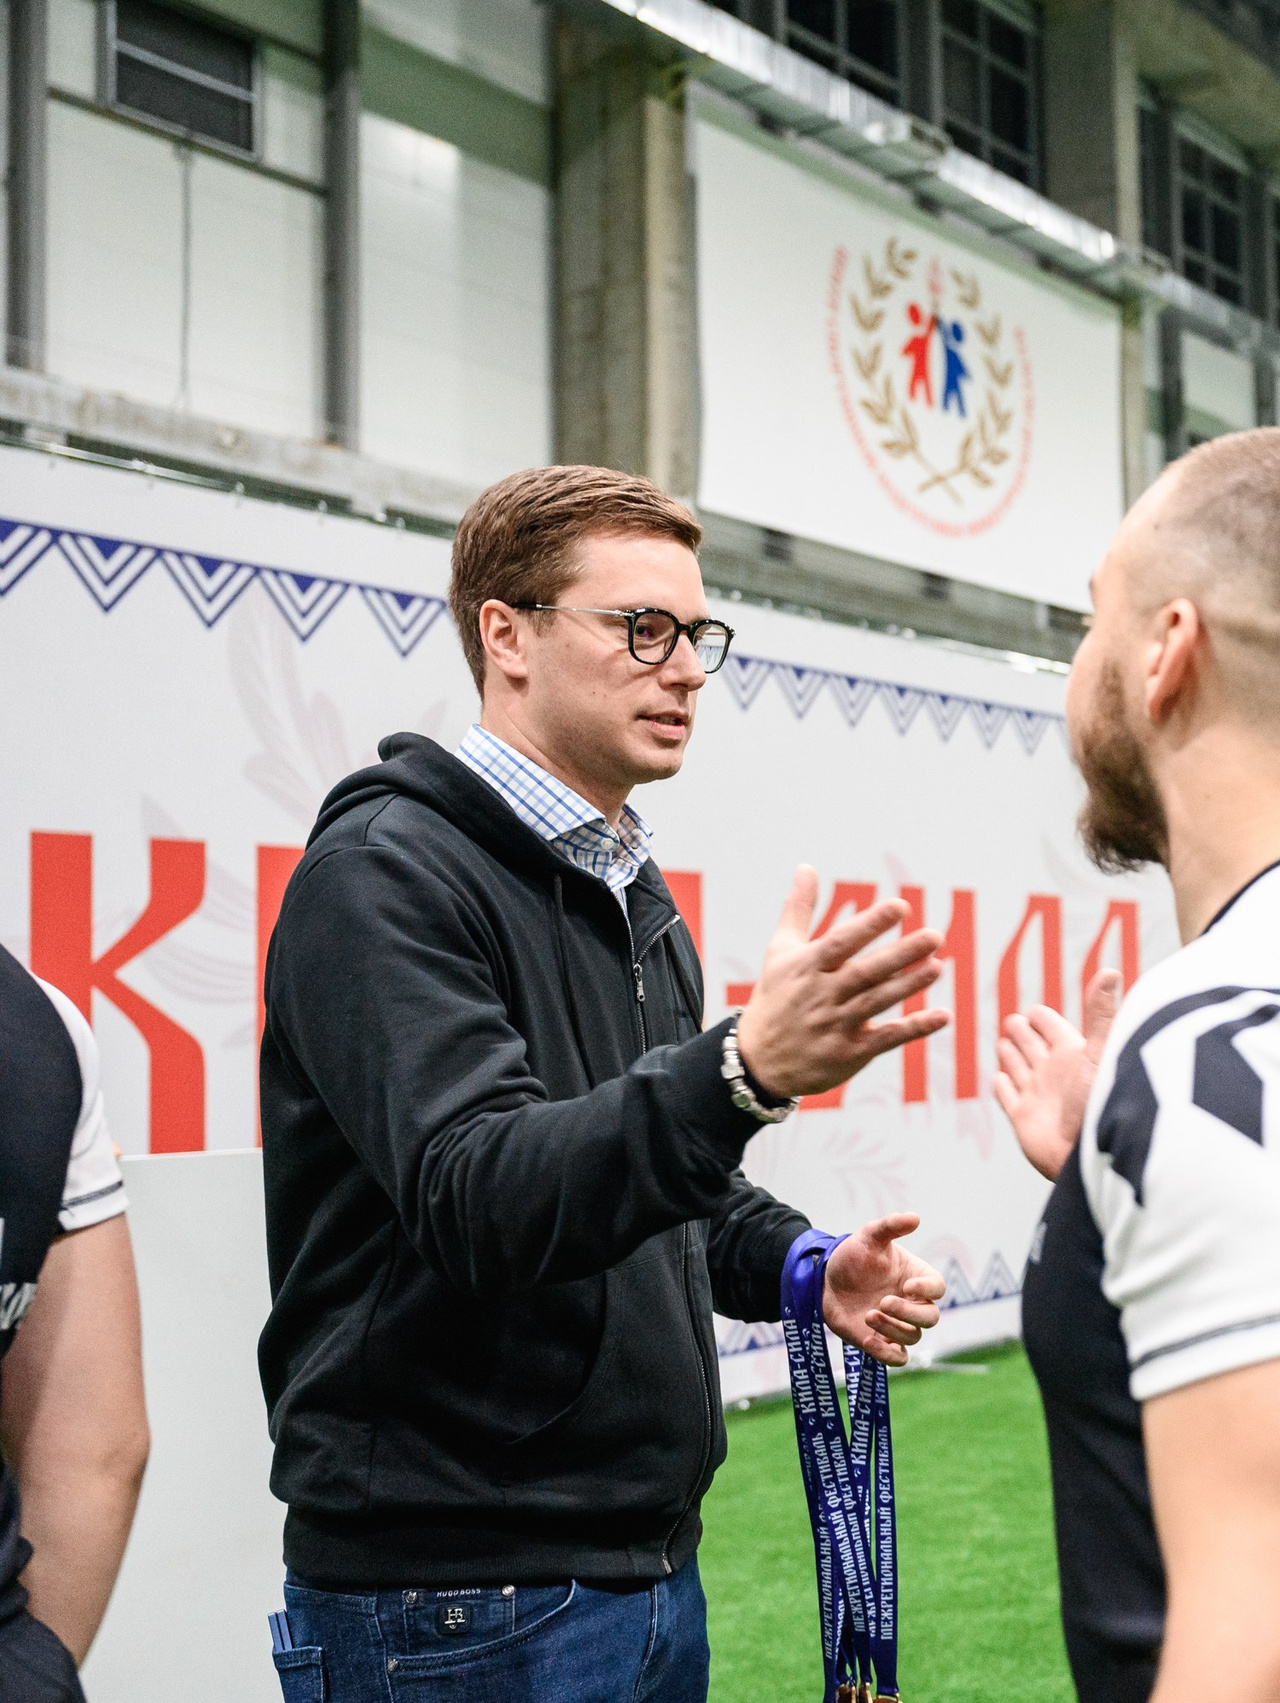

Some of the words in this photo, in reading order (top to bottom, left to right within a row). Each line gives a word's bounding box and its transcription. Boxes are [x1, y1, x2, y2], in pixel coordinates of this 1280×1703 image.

[811, 1432, 843, 1509] ФЕСТИВАЛЬ
[878, 1425, 893, 1504] ФЕСТИВАЛЬ
[827, 1509, 866, 1633] МЕЖРЕГИОНАЛЬНЫЙ
[878, 1506, 894, 1641] МЕЖРЕГИОНАЛЬНЫЙ
